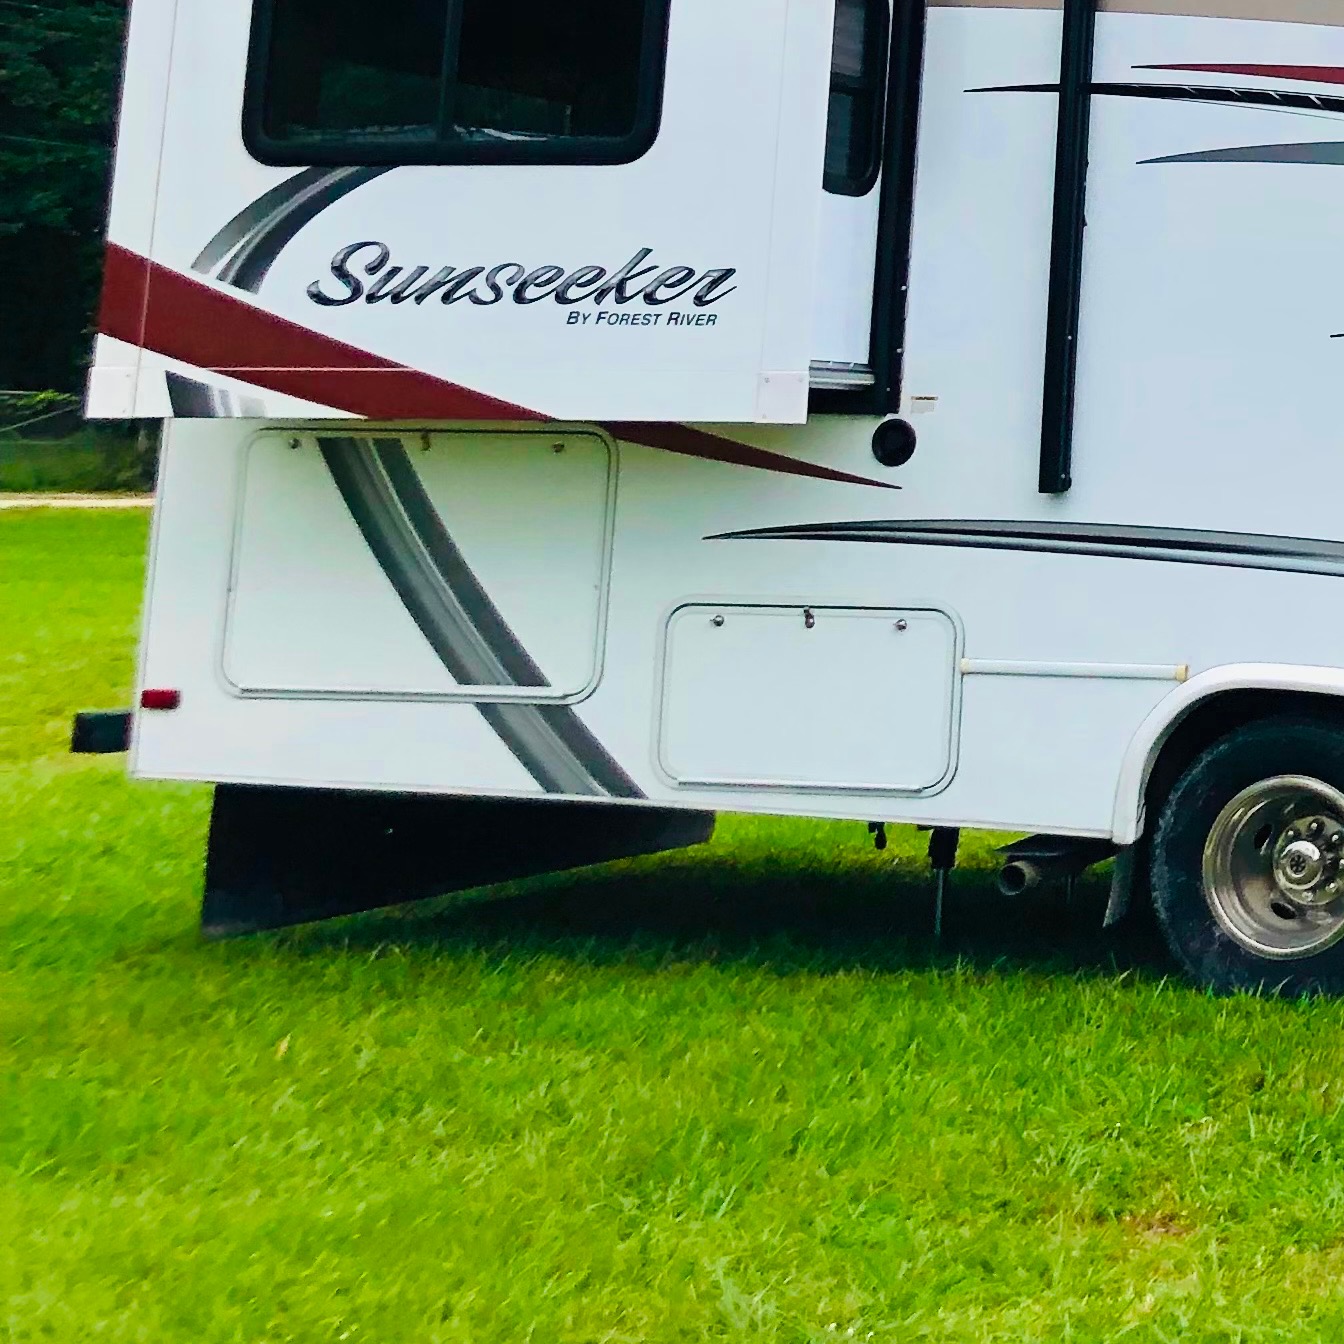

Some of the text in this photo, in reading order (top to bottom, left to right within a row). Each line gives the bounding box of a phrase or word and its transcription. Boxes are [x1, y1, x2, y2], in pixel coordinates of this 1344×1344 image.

[307, 241, 736, 307] Sunseeker
[596, 311, 661, 326] FOREST
[666, 311, 717, 326] RIVER
